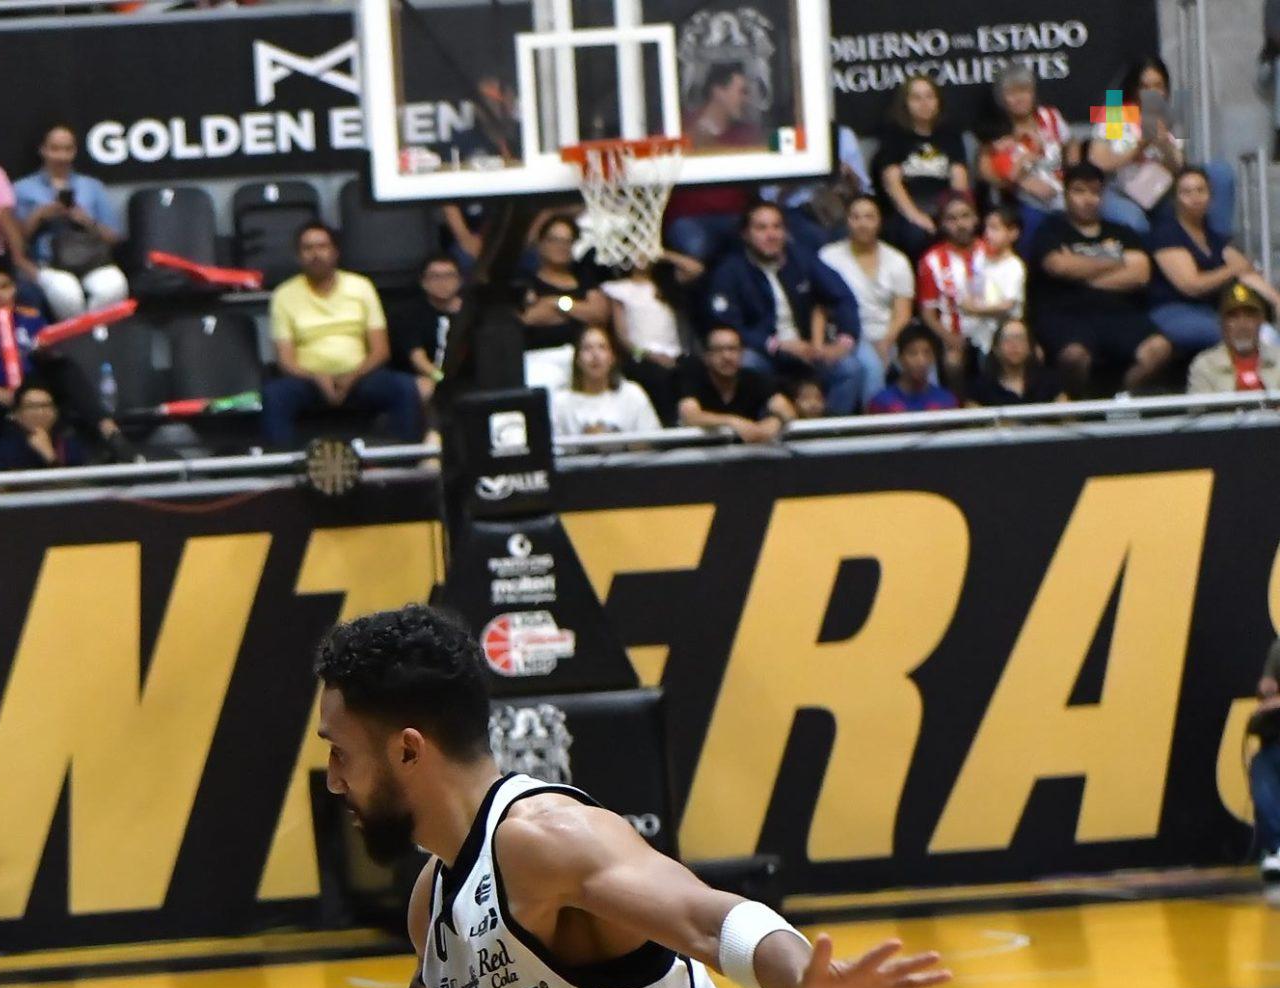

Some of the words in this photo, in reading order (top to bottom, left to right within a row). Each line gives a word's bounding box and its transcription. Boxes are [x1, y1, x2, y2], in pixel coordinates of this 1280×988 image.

[976, 20, 1088, 52] ESTADO
[86, 109, 317, 164] GOLDEN
[329, 101, 475, 150] EEN
[477, 939, 516, 978] Red
